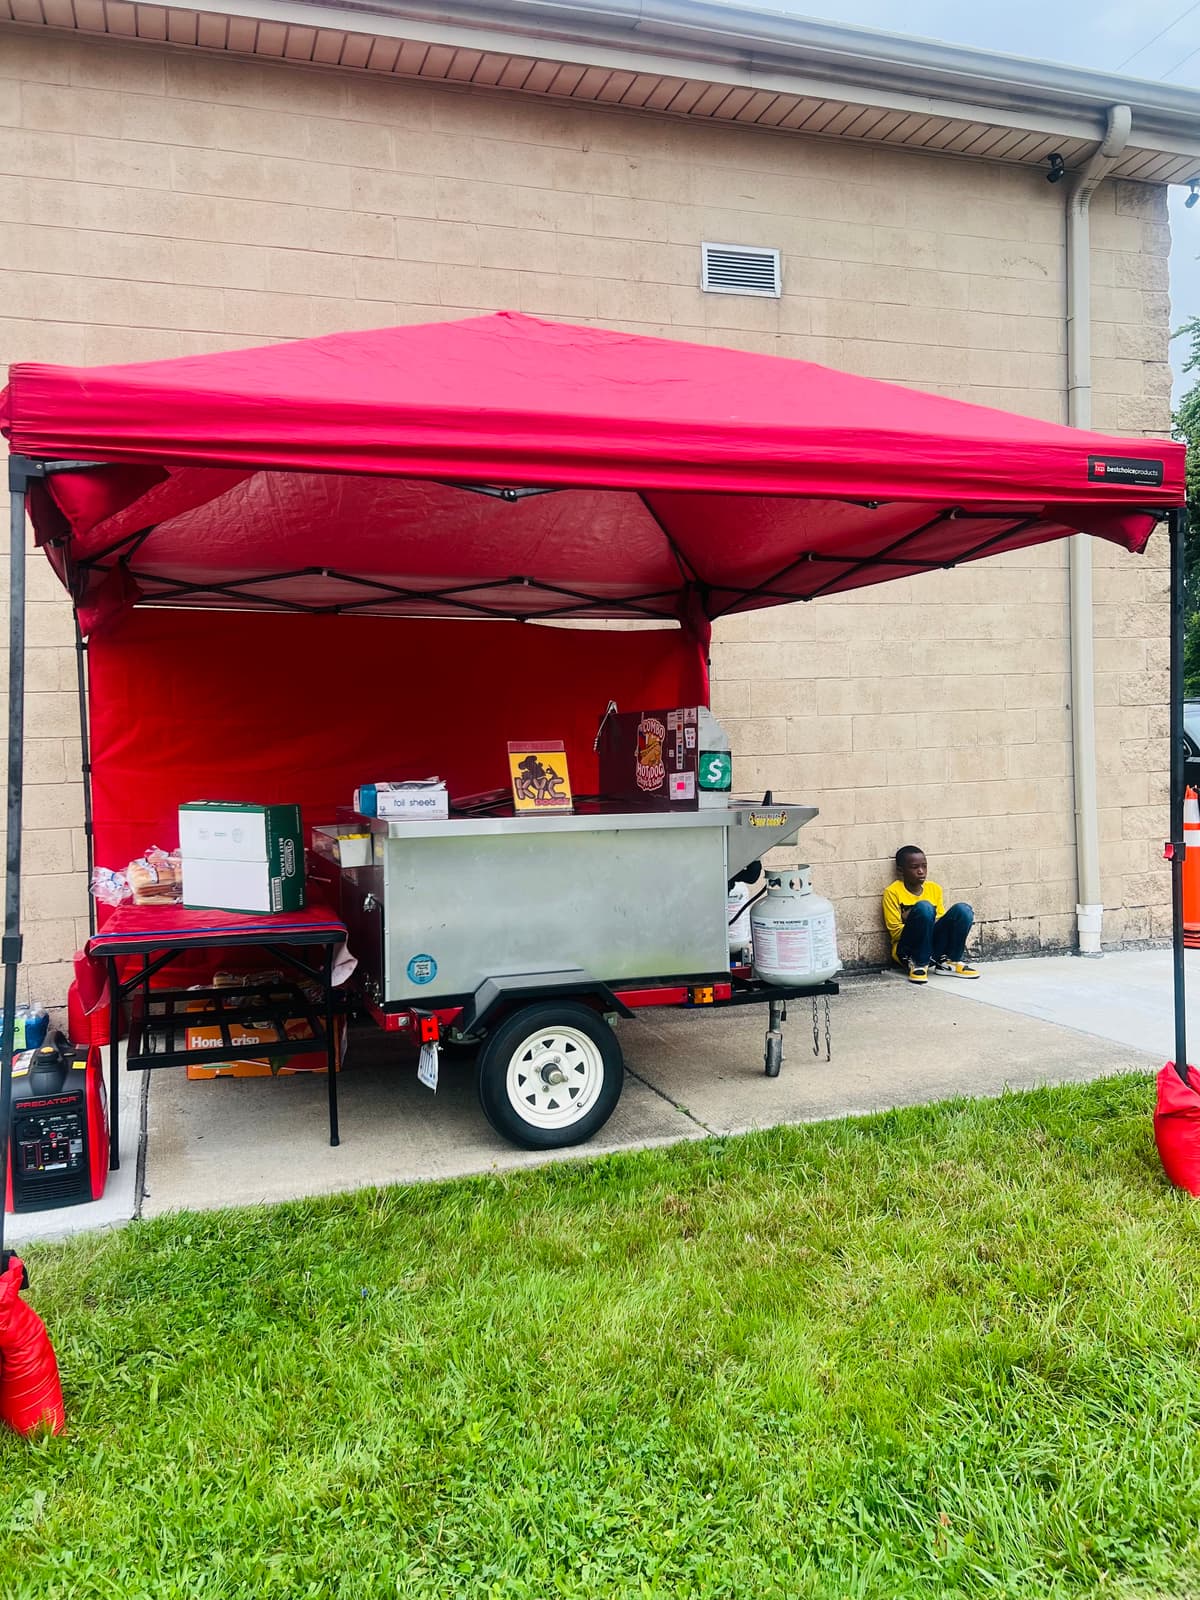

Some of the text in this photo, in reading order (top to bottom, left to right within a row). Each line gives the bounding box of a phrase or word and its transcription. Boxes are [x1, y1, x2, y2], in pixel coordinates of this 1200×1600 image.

[642, 719, 665, 739] COMBO
[638, 762, 664, 778] HOT DOG
[514, 777, 566, 800] KYC
[394, 798, 437, 807] foil sheets
[191, 1034, 259, 1048] Honecrisp
[15, 1095, 78, 1109] PREDATOR
